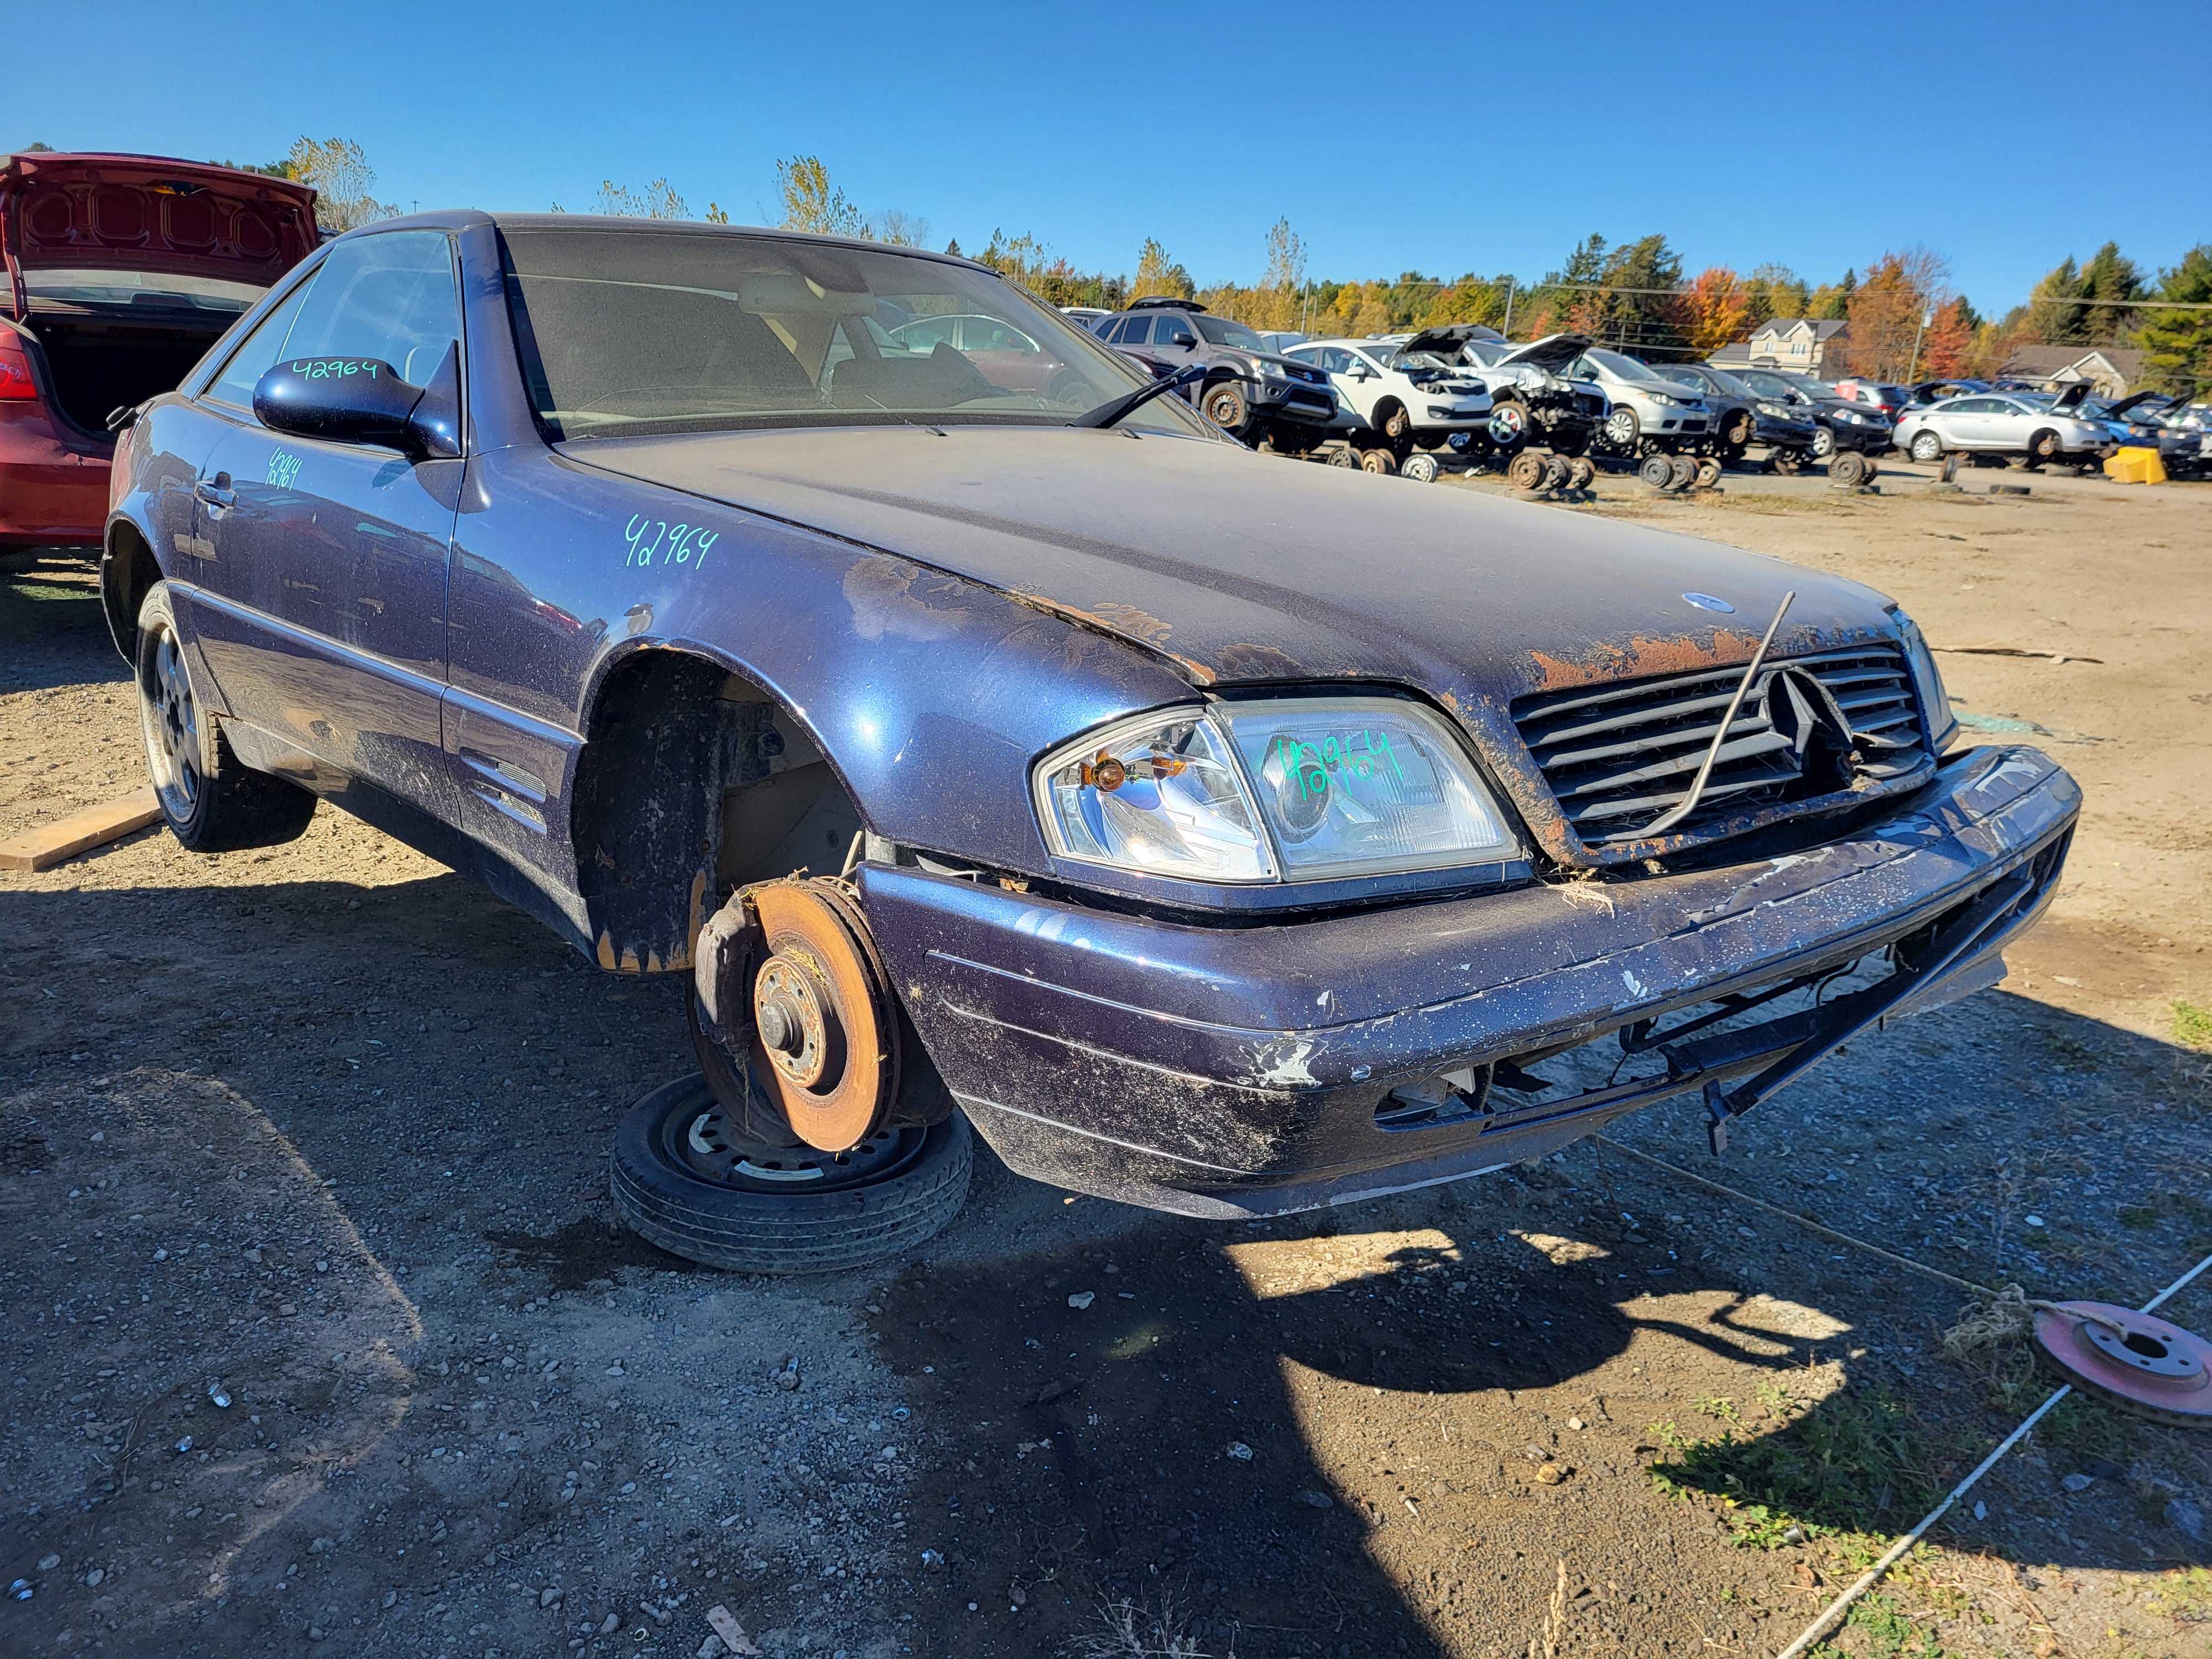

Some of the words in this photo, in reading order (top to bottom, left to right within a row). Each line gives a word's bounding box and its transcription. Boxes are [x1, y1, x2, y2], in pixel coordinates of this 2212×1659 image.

[293, 361, 377, 380] 42964
[265, 446, 303, 492] 42964
[625, 513, 719, 570] 42964
[1277, 729, 1404, 801] 42964
